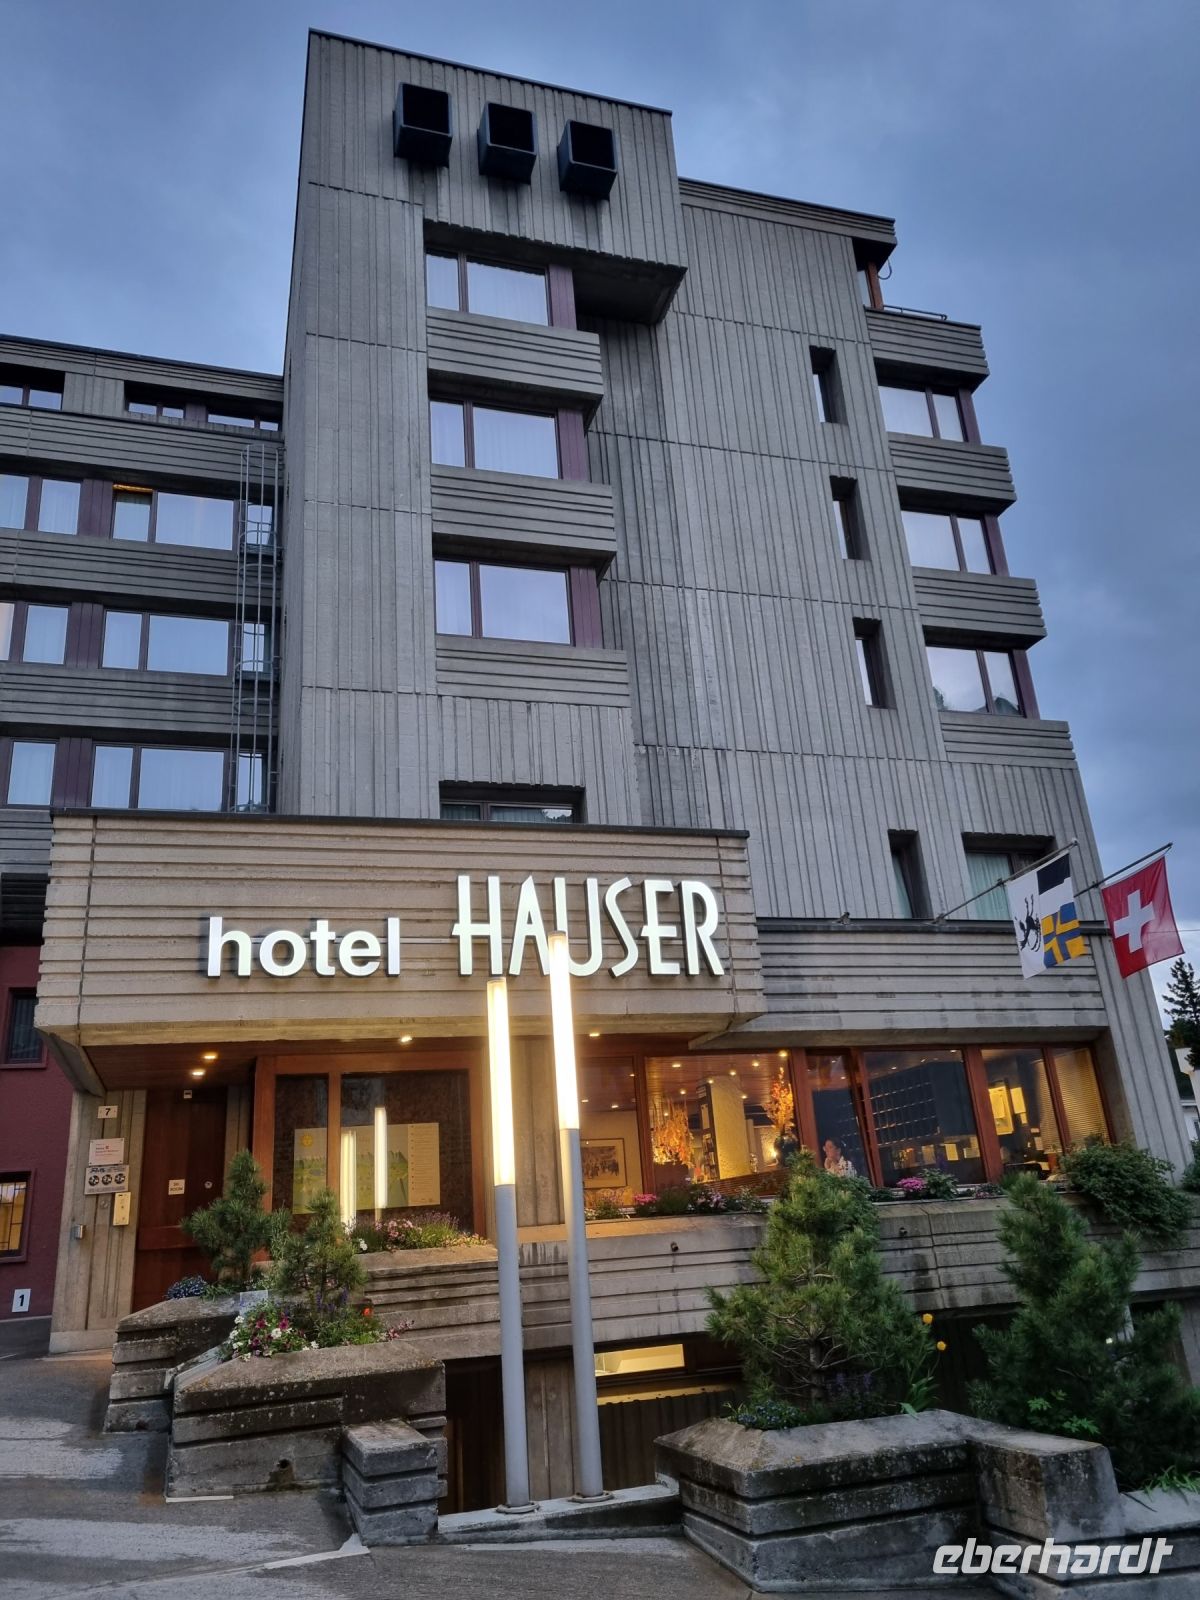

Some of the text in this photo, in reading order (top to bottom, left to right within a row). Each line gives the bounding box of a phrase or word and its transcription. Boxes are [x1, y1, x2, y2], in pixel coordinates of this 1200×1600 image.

[207, 875, 726, 977] hotel HAUSER
[105, 1107, 111, 1116] 7
[19, 1294, 25, 1307] 1
